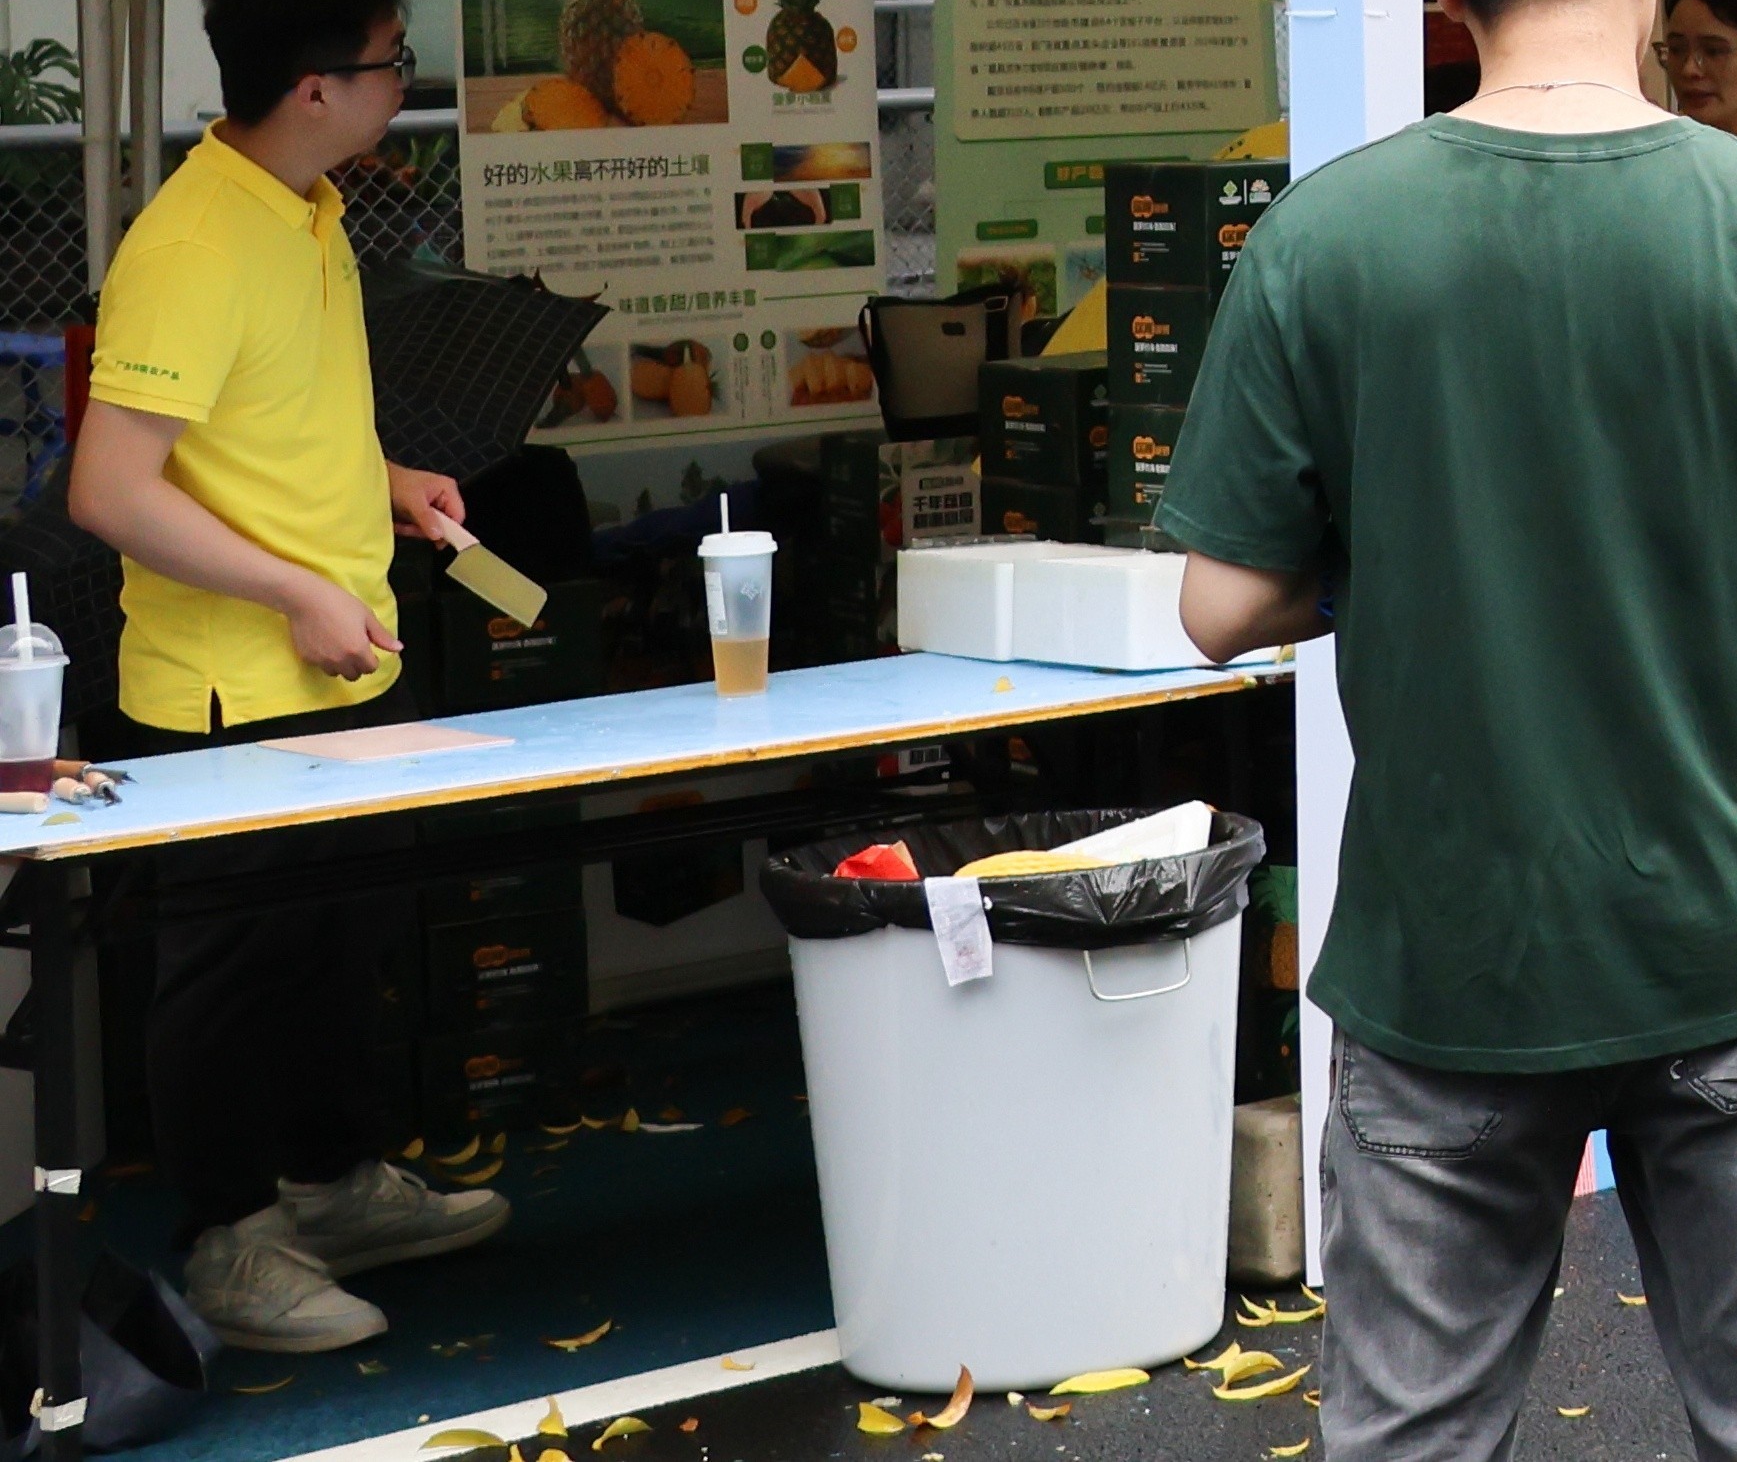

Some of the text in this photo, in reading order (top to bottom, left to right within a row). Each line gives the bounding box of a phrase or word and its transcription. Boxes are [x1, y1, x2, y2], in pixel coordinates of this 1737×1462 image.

[484, 154, 710, 186] 好的水果离不开好的土壤
